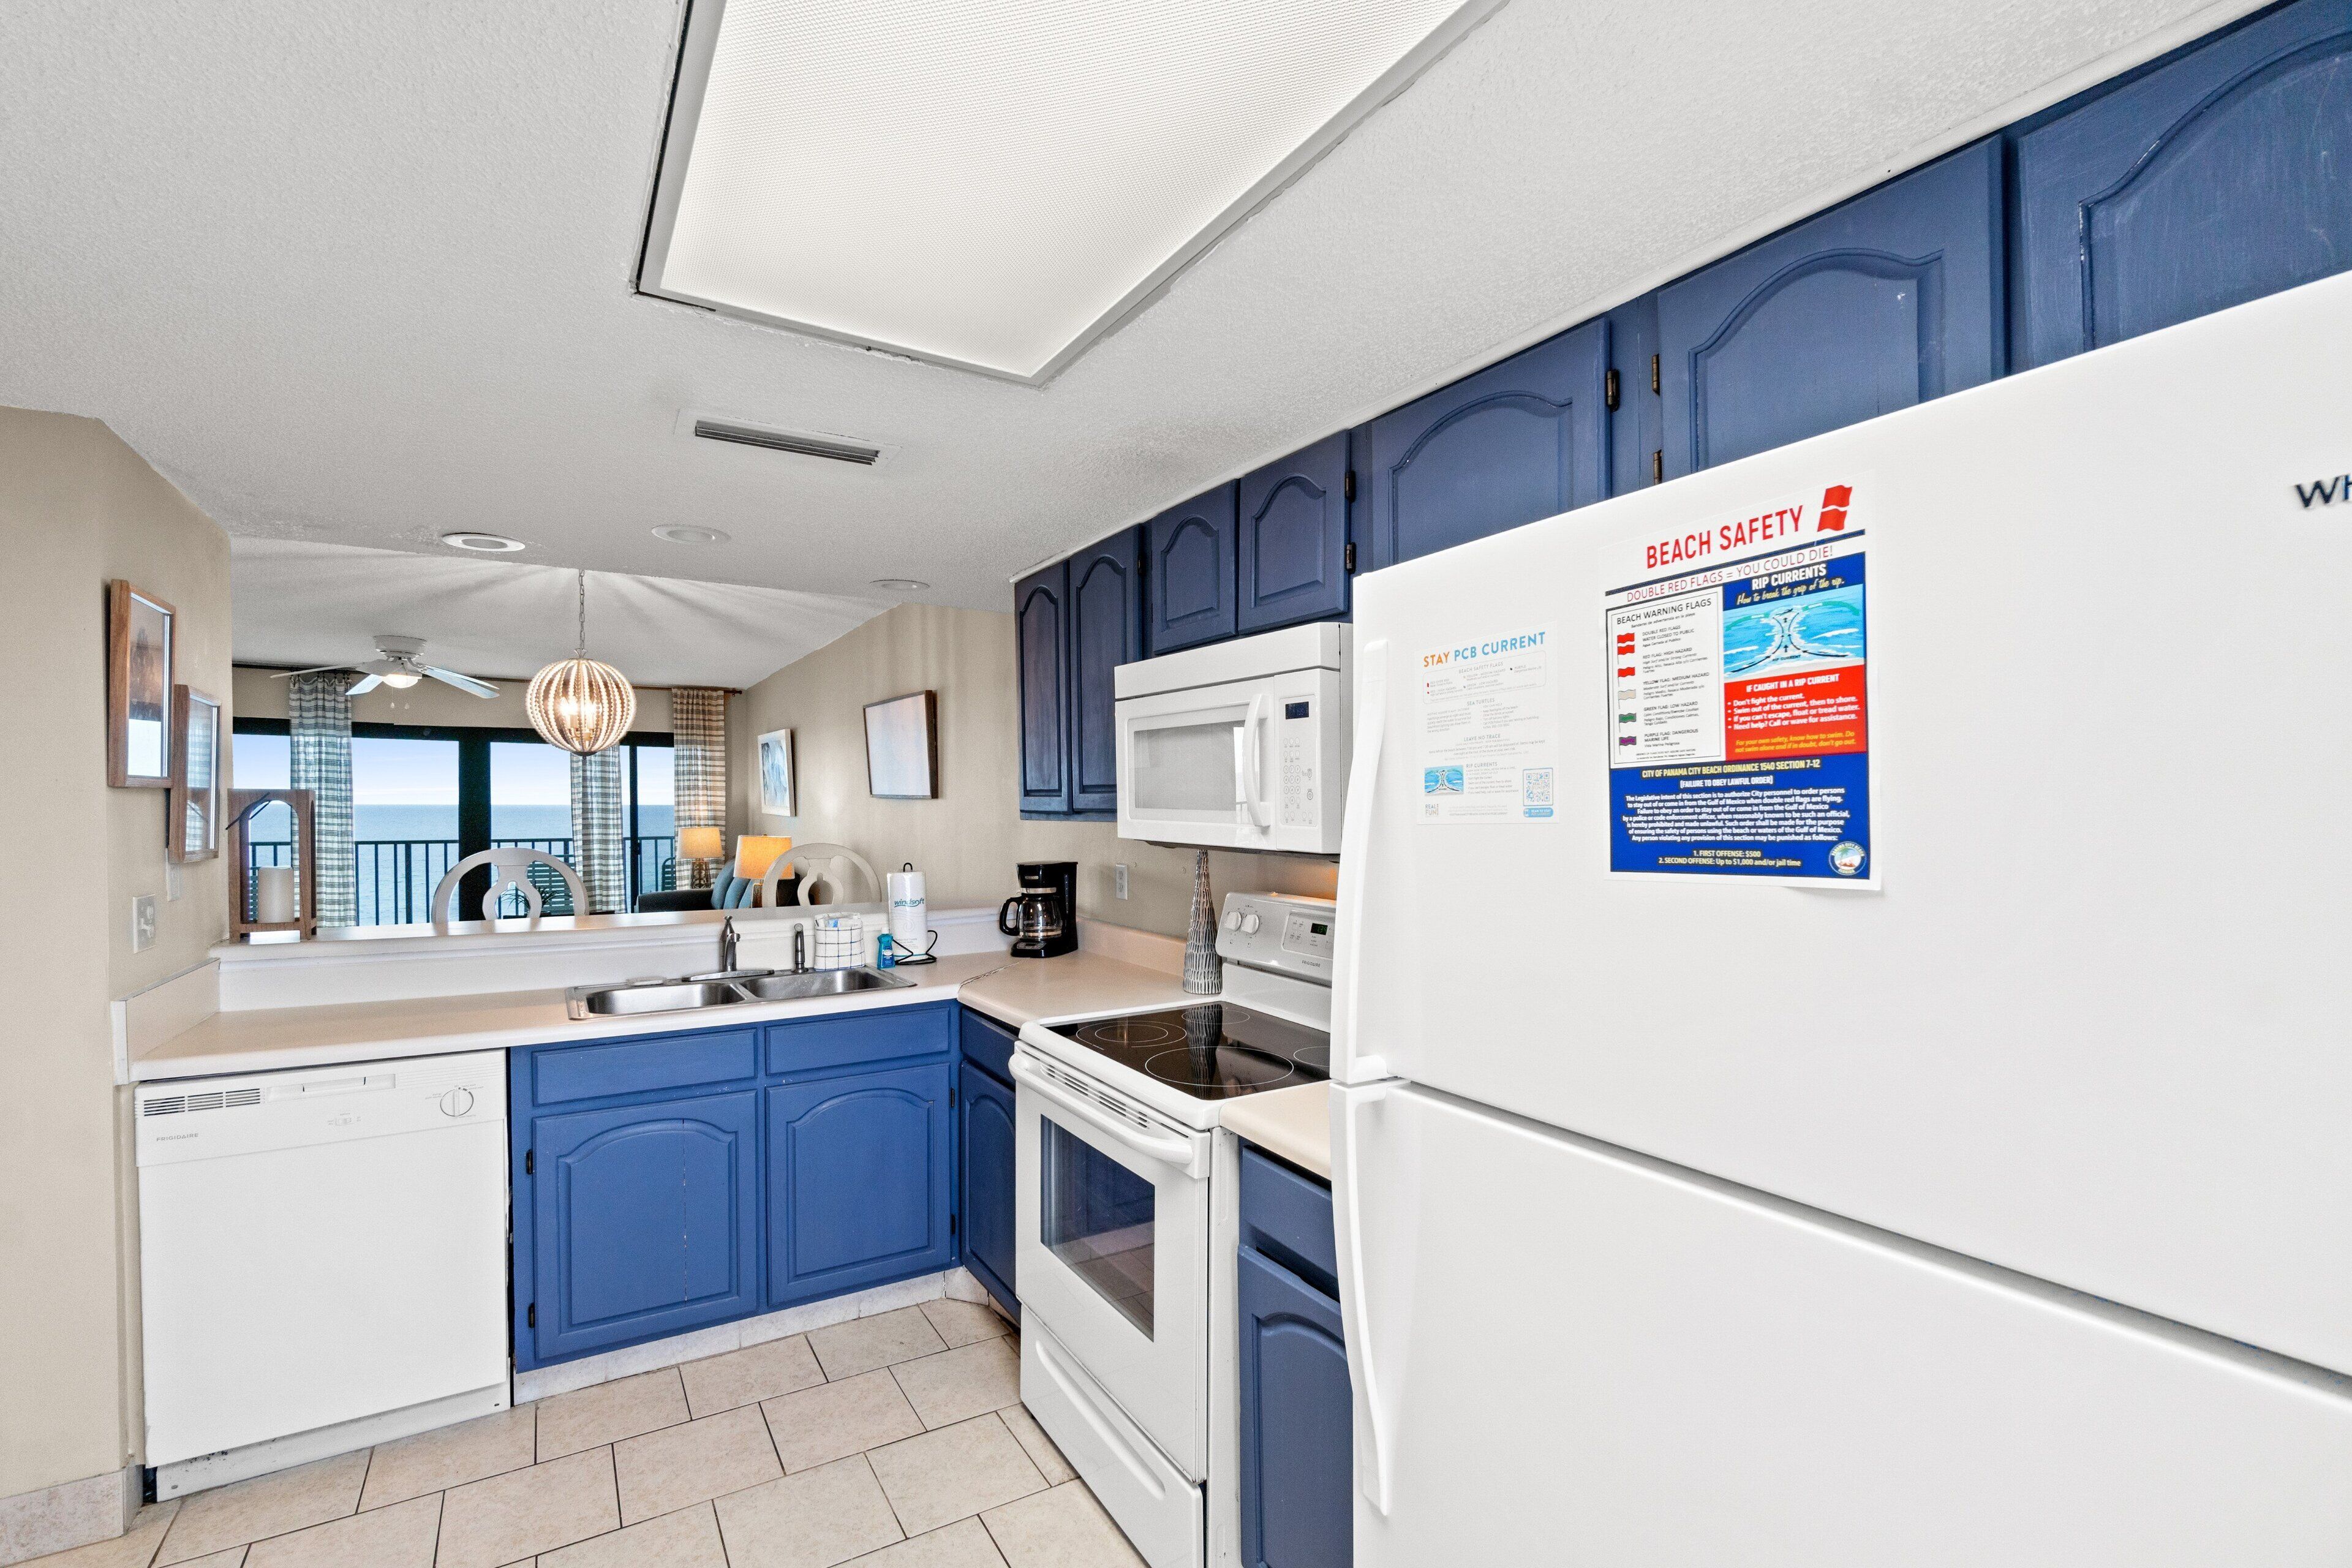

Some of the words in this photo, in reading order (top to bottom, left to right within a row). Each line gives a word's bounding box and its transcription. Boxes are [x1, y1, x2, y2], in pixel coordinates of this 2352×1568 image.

[1646, 529, 1711, 570] BEACH
[1719, 504, 1803, 551] SAFETY
[1627, 584, 1665, 602] DOUBLE
[1667, 578, 1687, 593] RED
[1690, 570, 1723, 588] FLAGS
[1736, 561, 1760, 578] YOU
[1763, 551, 1804, 571] COULD
[1808, 545, 1833, 562] DIE!
[1752, 576, 1768, 590] RIP
[1771, 563, 1826, 586] CURRENTS
[1736, 592, 1751, 605] How
[1753, 590, 1760, 601] to
[1762, 586, 1780, 600] break
[1781, 584, 1792, 596] the
[1792, 581, 1806, 596] grip
[1809, 578, 1818, 590] of
[1819, 576, 1829, 588] the
[1831, 573, 1844, 588] rip.
[1616, 613, 1641, 624] BEACH
[1644, 604, 1683, 619] WARNING
[1686, 598, 1711, 610] FLAGS
[1423, 650, 1449, 667] STAY
[1454, 644, 1476, 662] PCB
[1482, 631, 1545, 657] CURRENT
[1754, 681, 1778, 692] CAUGHT
[1779, 680, 1787, 688] IN
[1795, 677, 1806, 687] RIP
[1807, 673, 1839, 685] CURRENT
[1751, 696, 1766, 706] fight
[1779, 692, 1804, 701] current.
[1782, 699, 1808, 709] current,
[1836, 694, 1857, 703] shore.
[1768, 711, 1791, 720] escape,
[1818, 705, 1836, 714] tread
[1838, 703, 1860, 711] water.
[1751, 721, 1767, 729] help?
[1820, 712, 1857, 722] assistance.
[1663, 767, 1687, 776] PANAMA
[1724, 763, 1758, 772] ORDINANCE
[1760, 762, 1775, 771] 1540
[1776, 760, 1805, 769] SECTION
[1806, 759, 1820, 767] 7-12
[1679, 779, 1703, 788] (FAILURE
[1712, 778, 1726, 786] OBEY
[1727, 777, 1750, 786] LAWFUL
[1751, 775, 1773, 785] ORDER)
[894, 897, 924, 908] windsoft
[156, 1133, 199, 1141] FRIGIDAIRE
